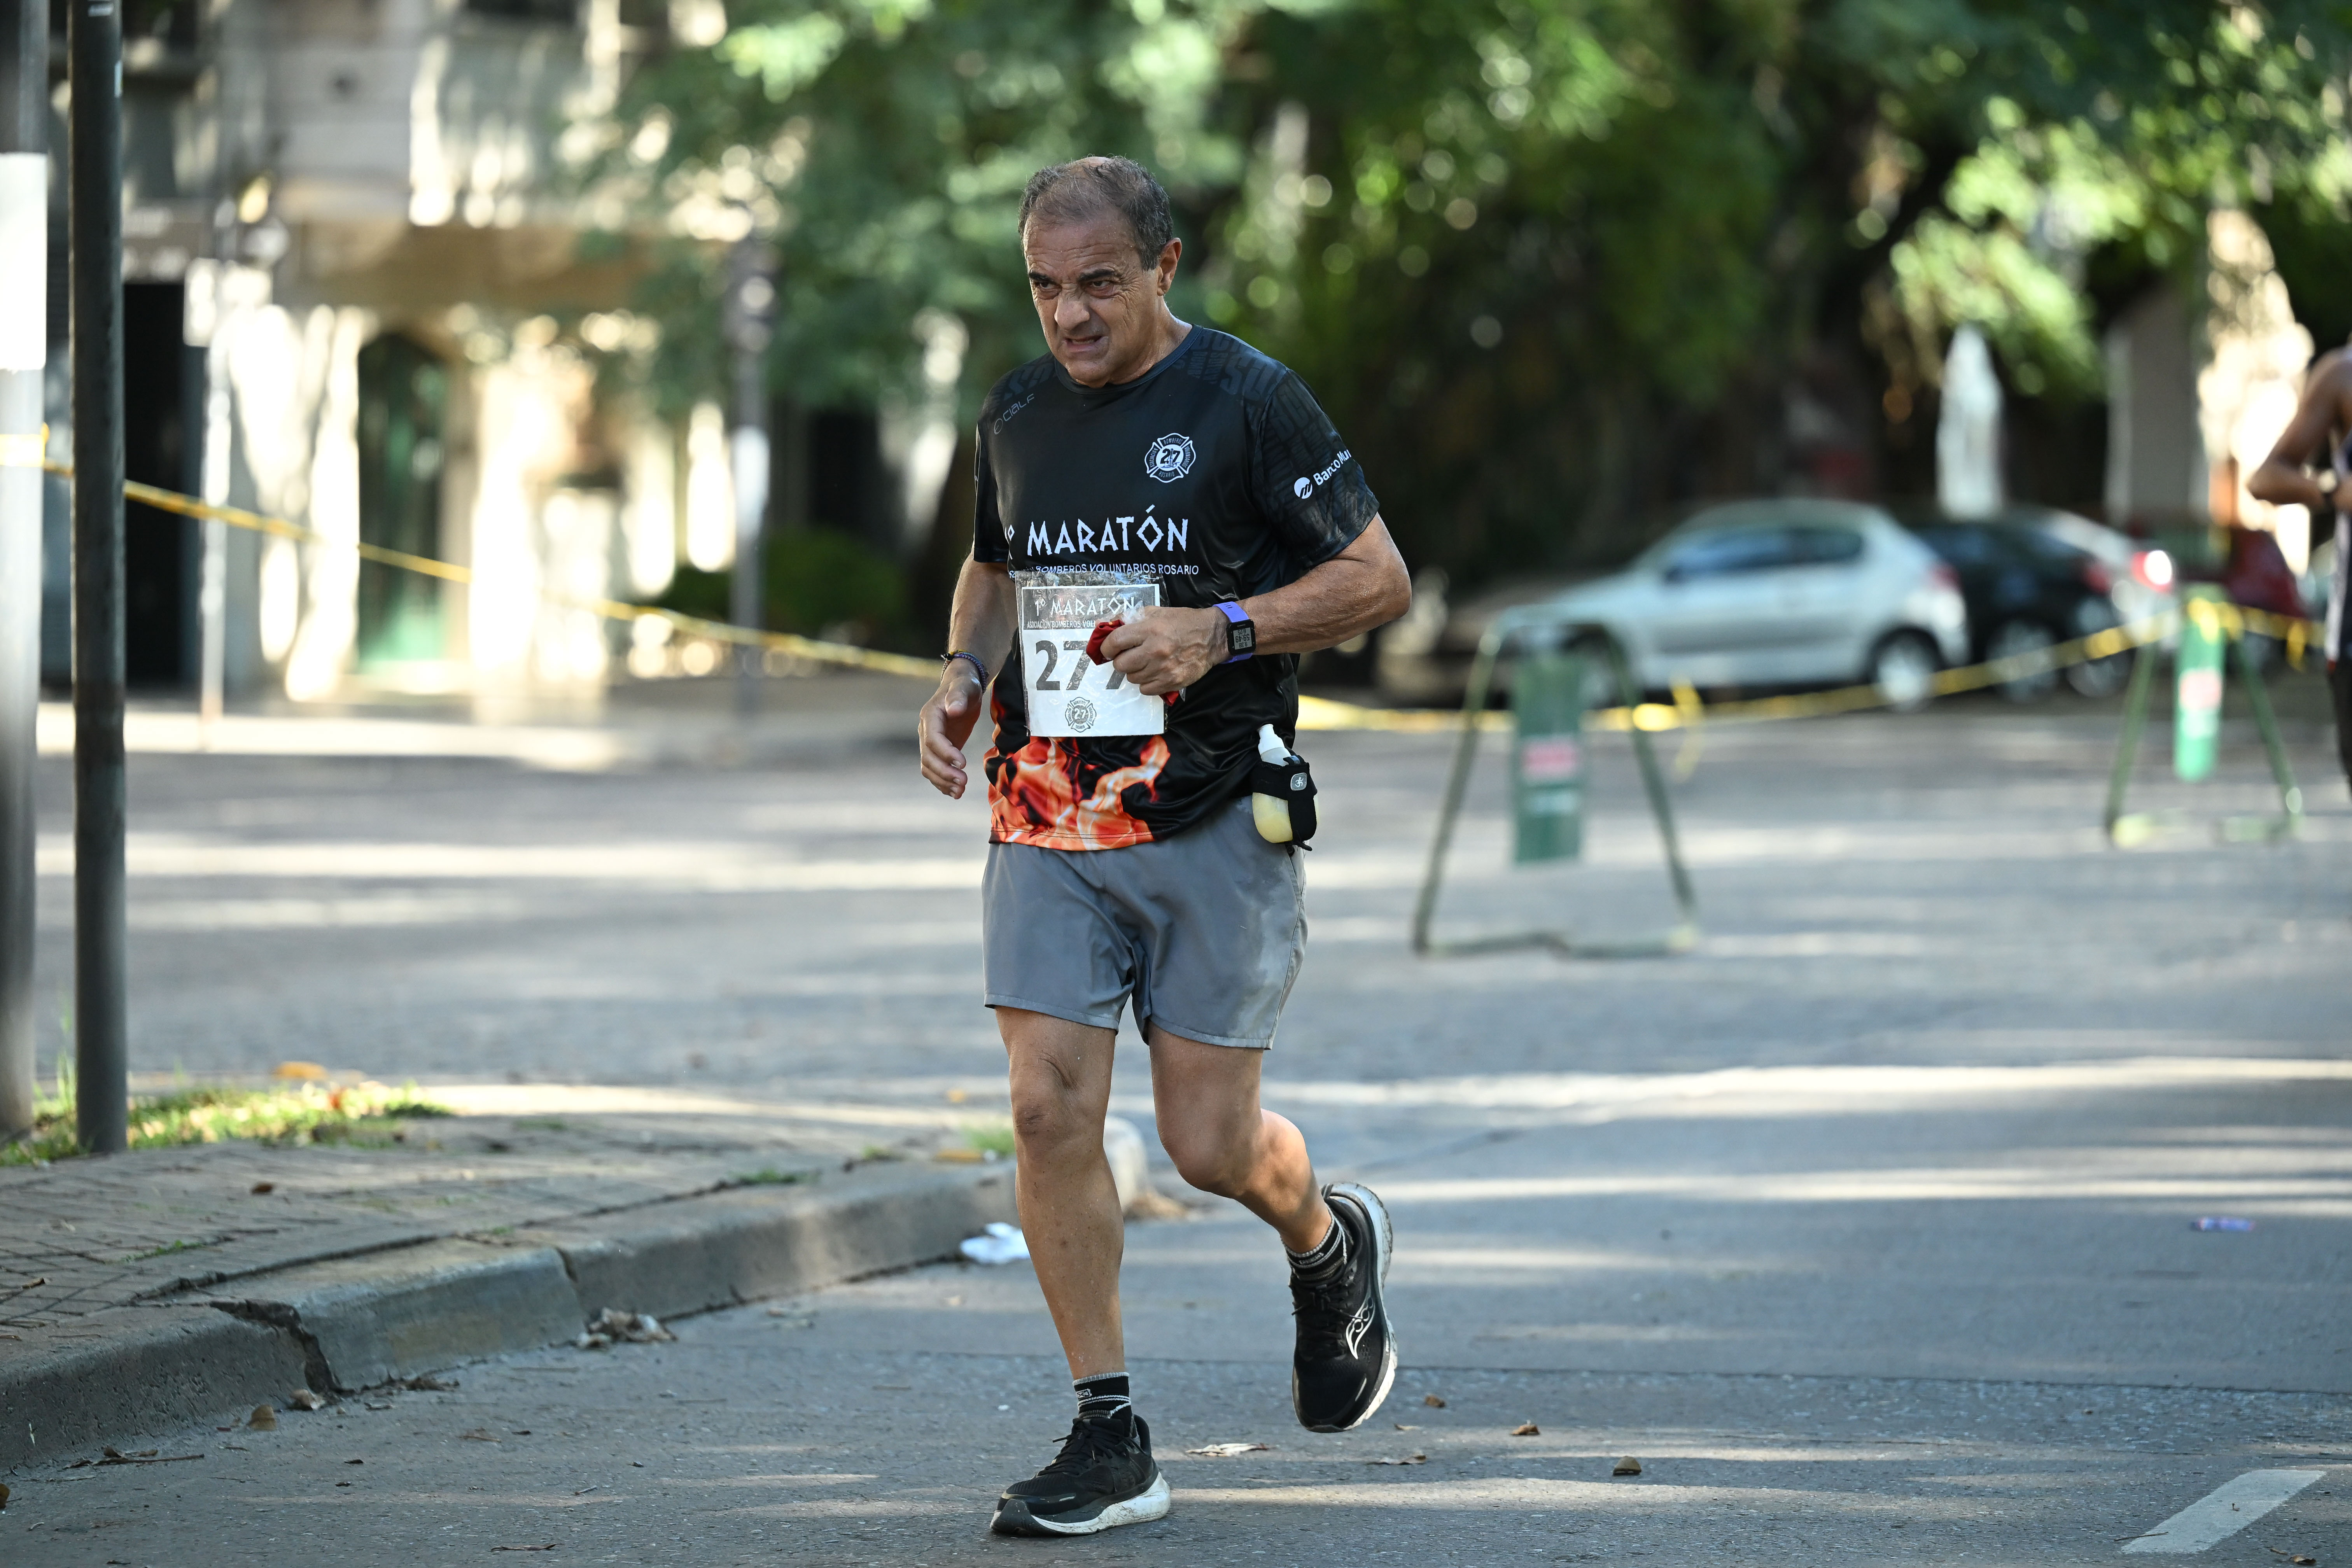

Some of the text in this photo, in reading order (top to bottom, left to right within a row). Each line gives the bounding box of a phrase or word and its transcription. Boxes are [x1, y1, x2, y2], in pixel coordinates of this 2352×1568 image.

[1160, 448, 1181, 464] 27
[1313, 461, 1340, 485] Banco
[1027, 504, 1188, 556] MARATÓN
[1089, 564, 1157, 574] VOLUNTARIOS
[1158, 564, 1199, 575] ROSARIO
[1050, 592, 1134, 616] MARATÓN
[1052, 620, 1081, 628] BOMBEROS
[1235, 634, 1250, 643] 59:49
[1074, 707, 1087, 719] 27
